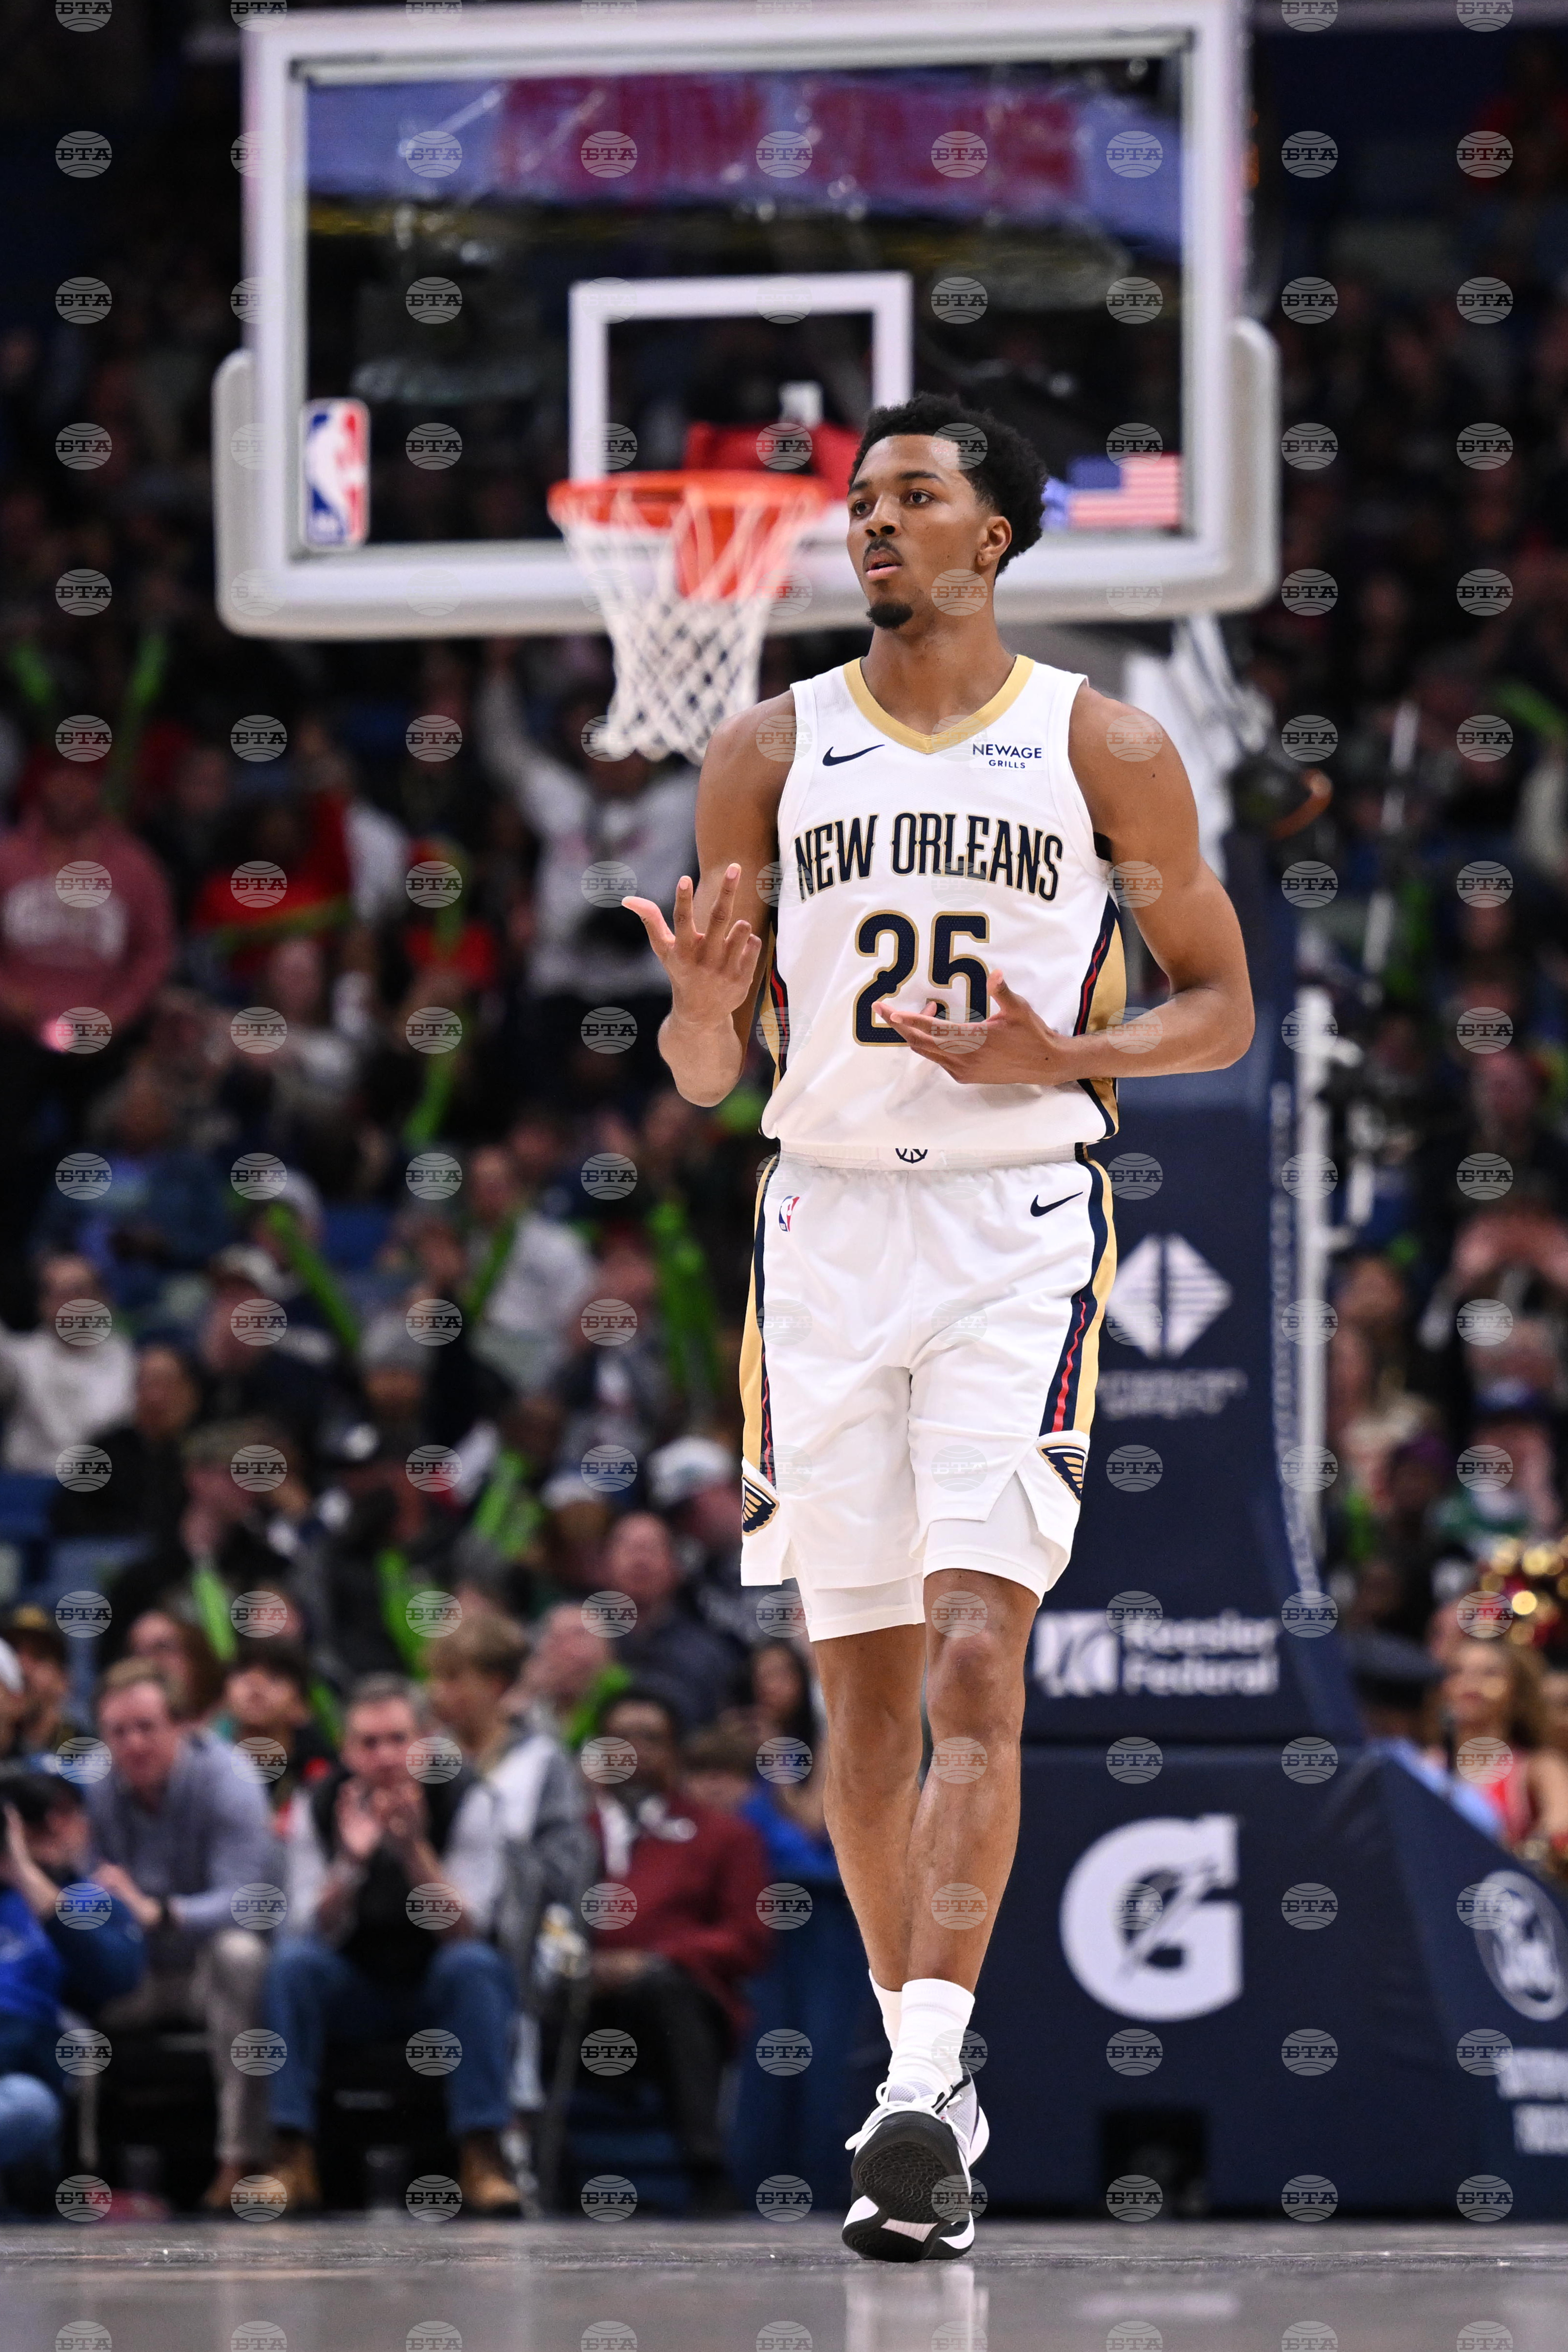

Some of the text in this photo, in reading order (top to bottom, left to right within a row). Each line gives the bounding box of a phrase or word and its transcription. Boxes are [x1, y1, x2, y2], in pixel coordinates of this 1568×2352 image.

[973, 743, 1042, 759] NEWAGE
[989, 760, 1026, 768] GRILLS
[794, 812, 1063, 904] NEW ORLEANS
[852, 909, 990, 1047] 25
